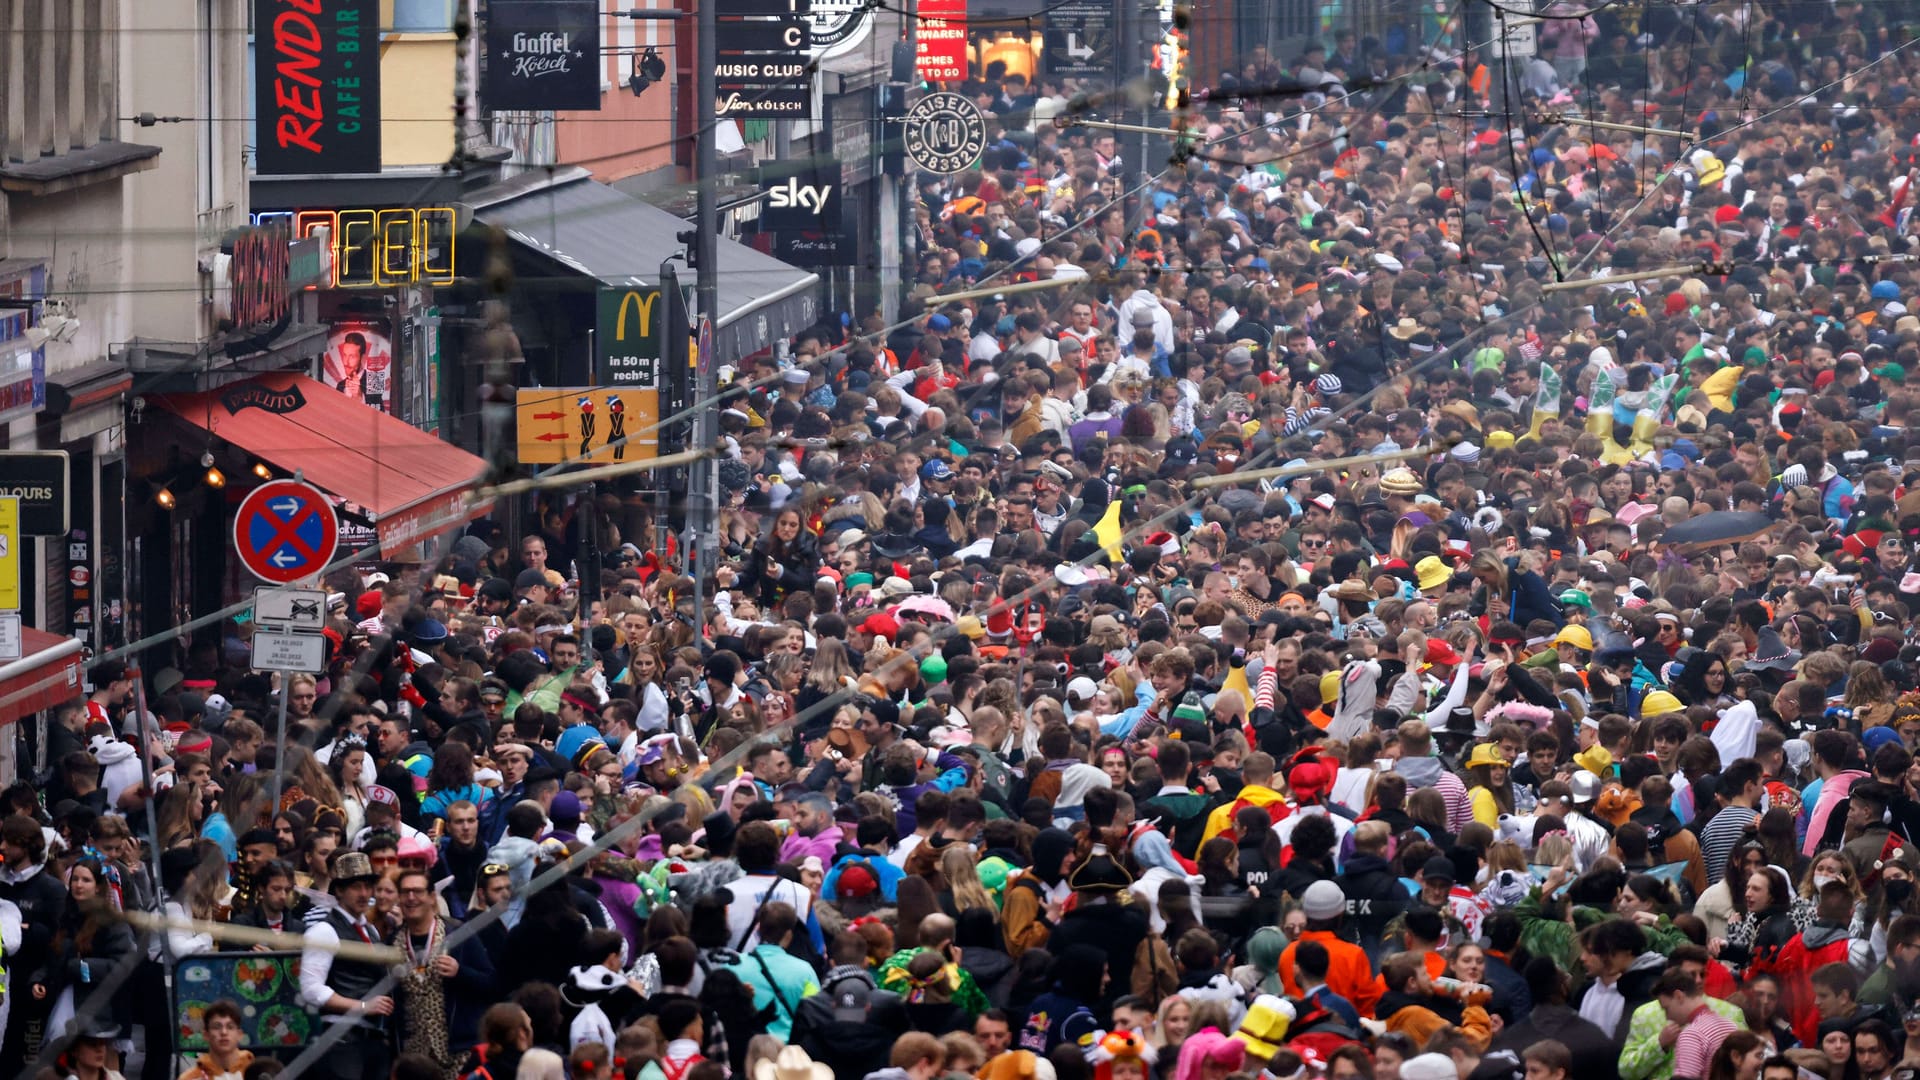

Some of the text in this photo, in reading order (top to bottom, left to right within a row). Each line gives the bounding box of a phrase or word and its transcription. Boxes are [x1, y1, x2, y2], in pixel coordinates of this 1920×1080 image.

[513, 32, 571, 55] Gaffel
[332, 9, 361, 134] CAFÉ BAR
[511, 54, 571, 78] Kölsch
[715, 65, 803, 77] MUSIC CLUB
[944, 69, 960, 77] GO
[715, 92, 802, 115] Sion KÖLSCH
[931, 120, 959, 148] K&B
[910, 141, 979, 171] 9383320
[769, 176, 832, 215] sky
[609, 356, 649, 366] in 50 m
[613, 370, 649, 380] rechts
